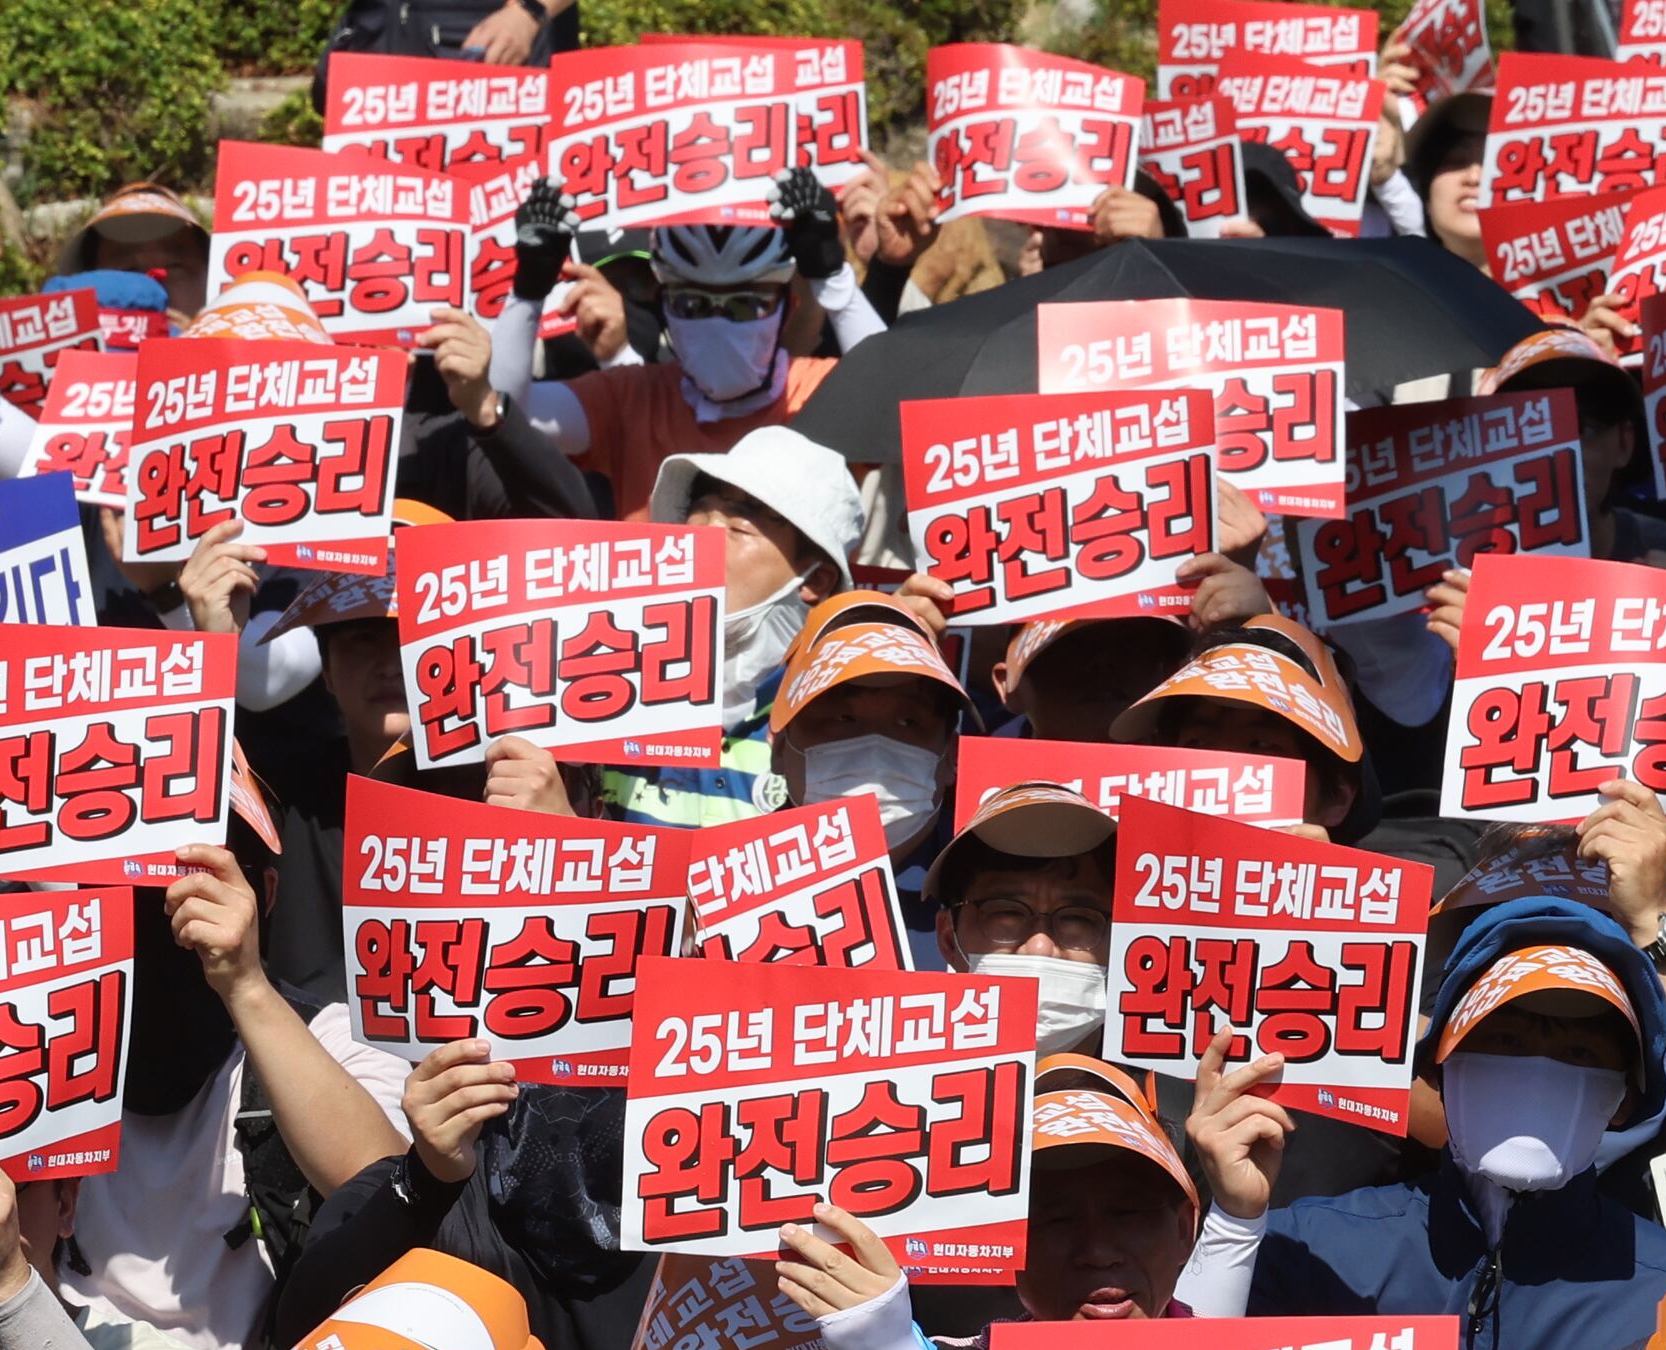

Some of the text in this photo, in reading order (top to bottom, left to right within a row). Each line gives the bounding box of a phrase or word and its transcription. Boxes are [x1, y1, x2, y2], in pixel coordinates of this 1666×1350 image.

[559, 102, 787, 218] 완전승리
[934, 116, 1131, 211] 완전승리
[924, 396, 1191, 492] 25년 단체교섭
[1411, 397, 1556, 472] 단체교섭
[135, 415, 394, 552] 완전승리
[525, 535, 696, 601] 단체교섭
[924, 453, 1213, 615] 완전승리
[1311, 447, 1578, 622] 완전승리
[1483, 597, 1593, 659] 25년
[23, 641, 204, 706] 단체교섭
[415, 594, 717, 759] 완전승리
[1203, 671, 1349, 748] 완전승리
[645, 743, 711, 759] 현대자동차지부
[460, 835, 656, 891] 단체교섭
[1234, 861, 1402, 924] 단체교섭
[355, 907, 682, 1044] 완전승리
[1121, 933, 1416, 1063] 완전승리
[655, 986, 1000, 1077] 25년 단체교섭
[638, 1061, 1023, 1243] 완전승리
[1337, 1097, 1400, 1125] 현대자동차지부
[47, 1149, 112, 1169] 현대자동차지부
[932, 1241, 1014, 1259] 현대자동차지부
